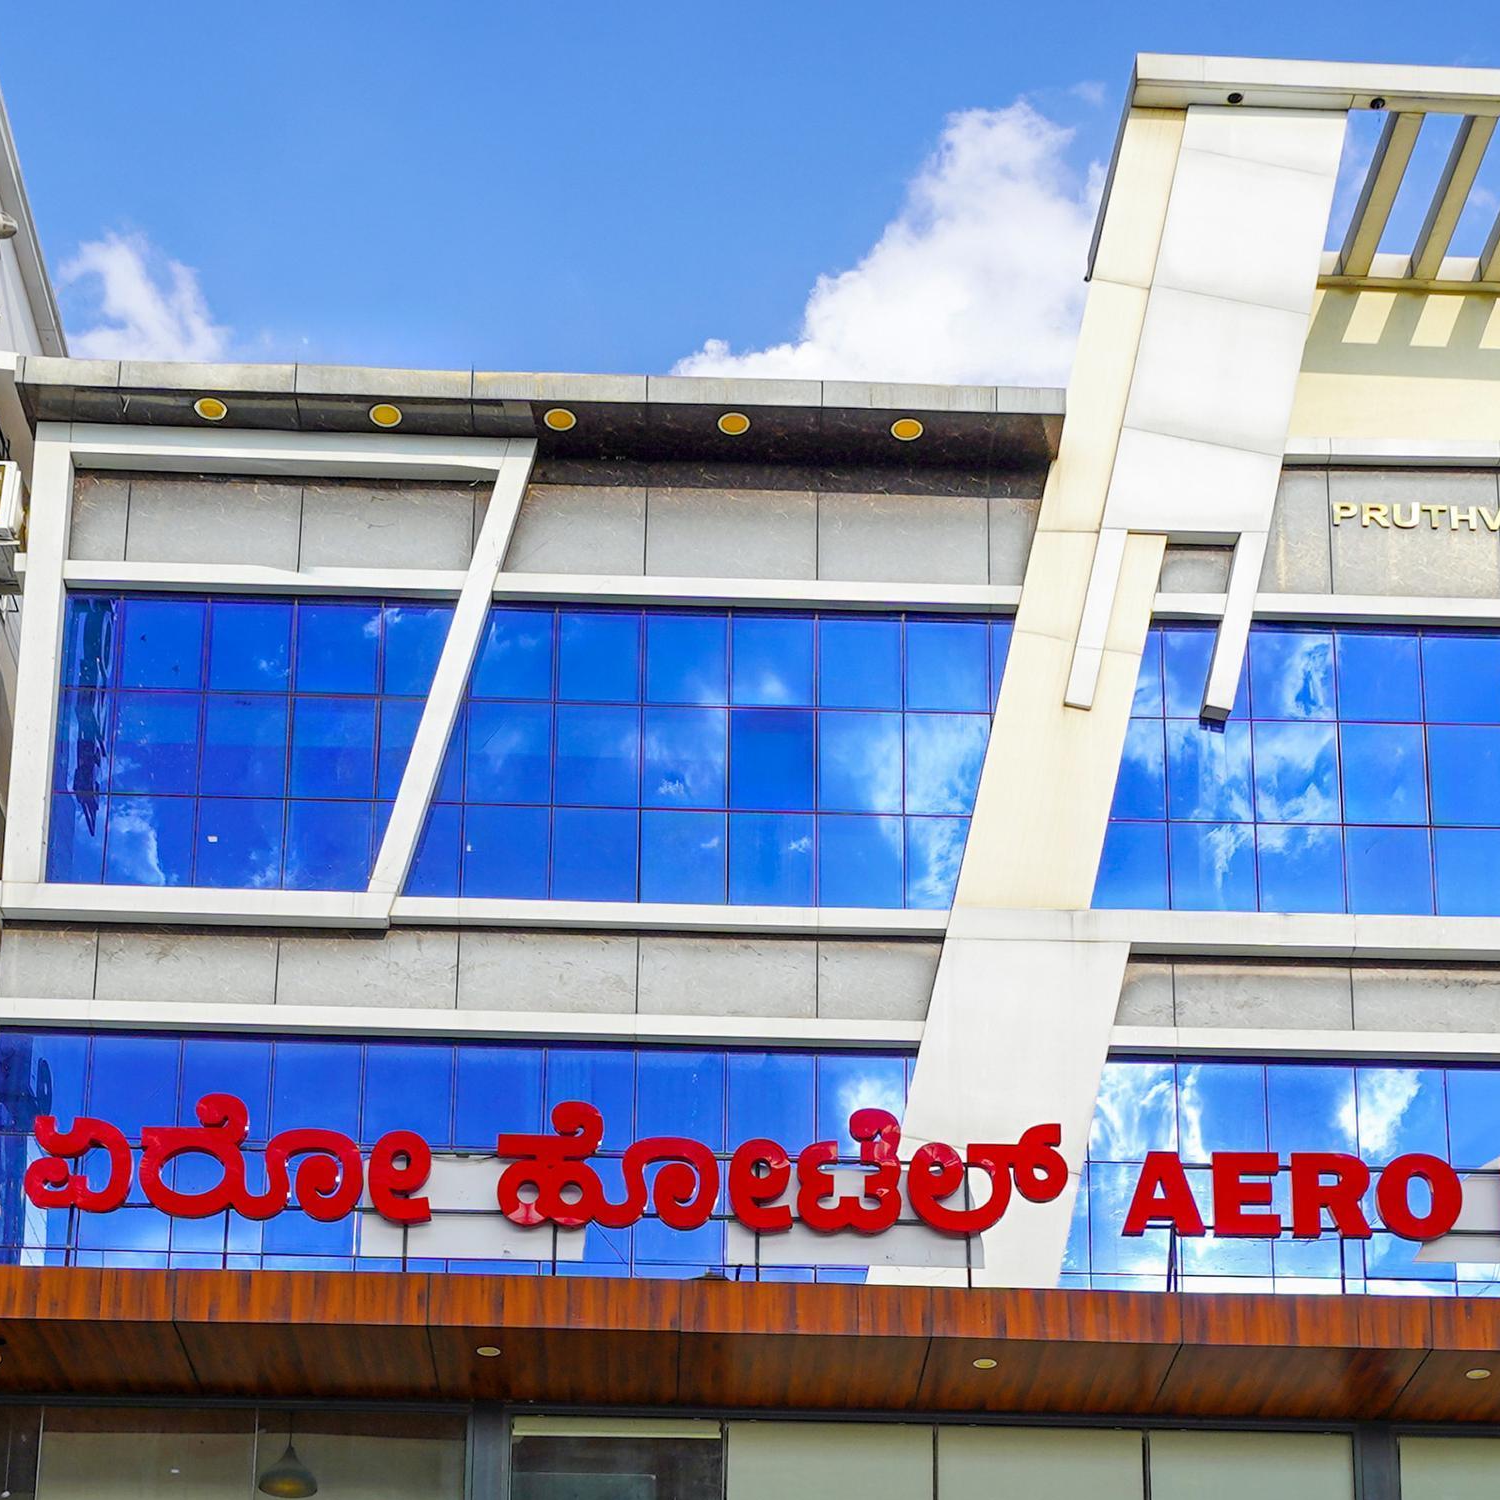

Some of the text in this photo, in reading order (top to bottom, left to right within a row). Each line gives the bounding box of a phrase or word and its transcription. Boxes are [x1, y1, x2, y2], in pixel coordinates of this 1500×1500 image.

[22, 1091, 1069, 1236] ಏರೋ ಹೋಟೆಲ್
[1121, 1151, 1463, 1243] AERO
